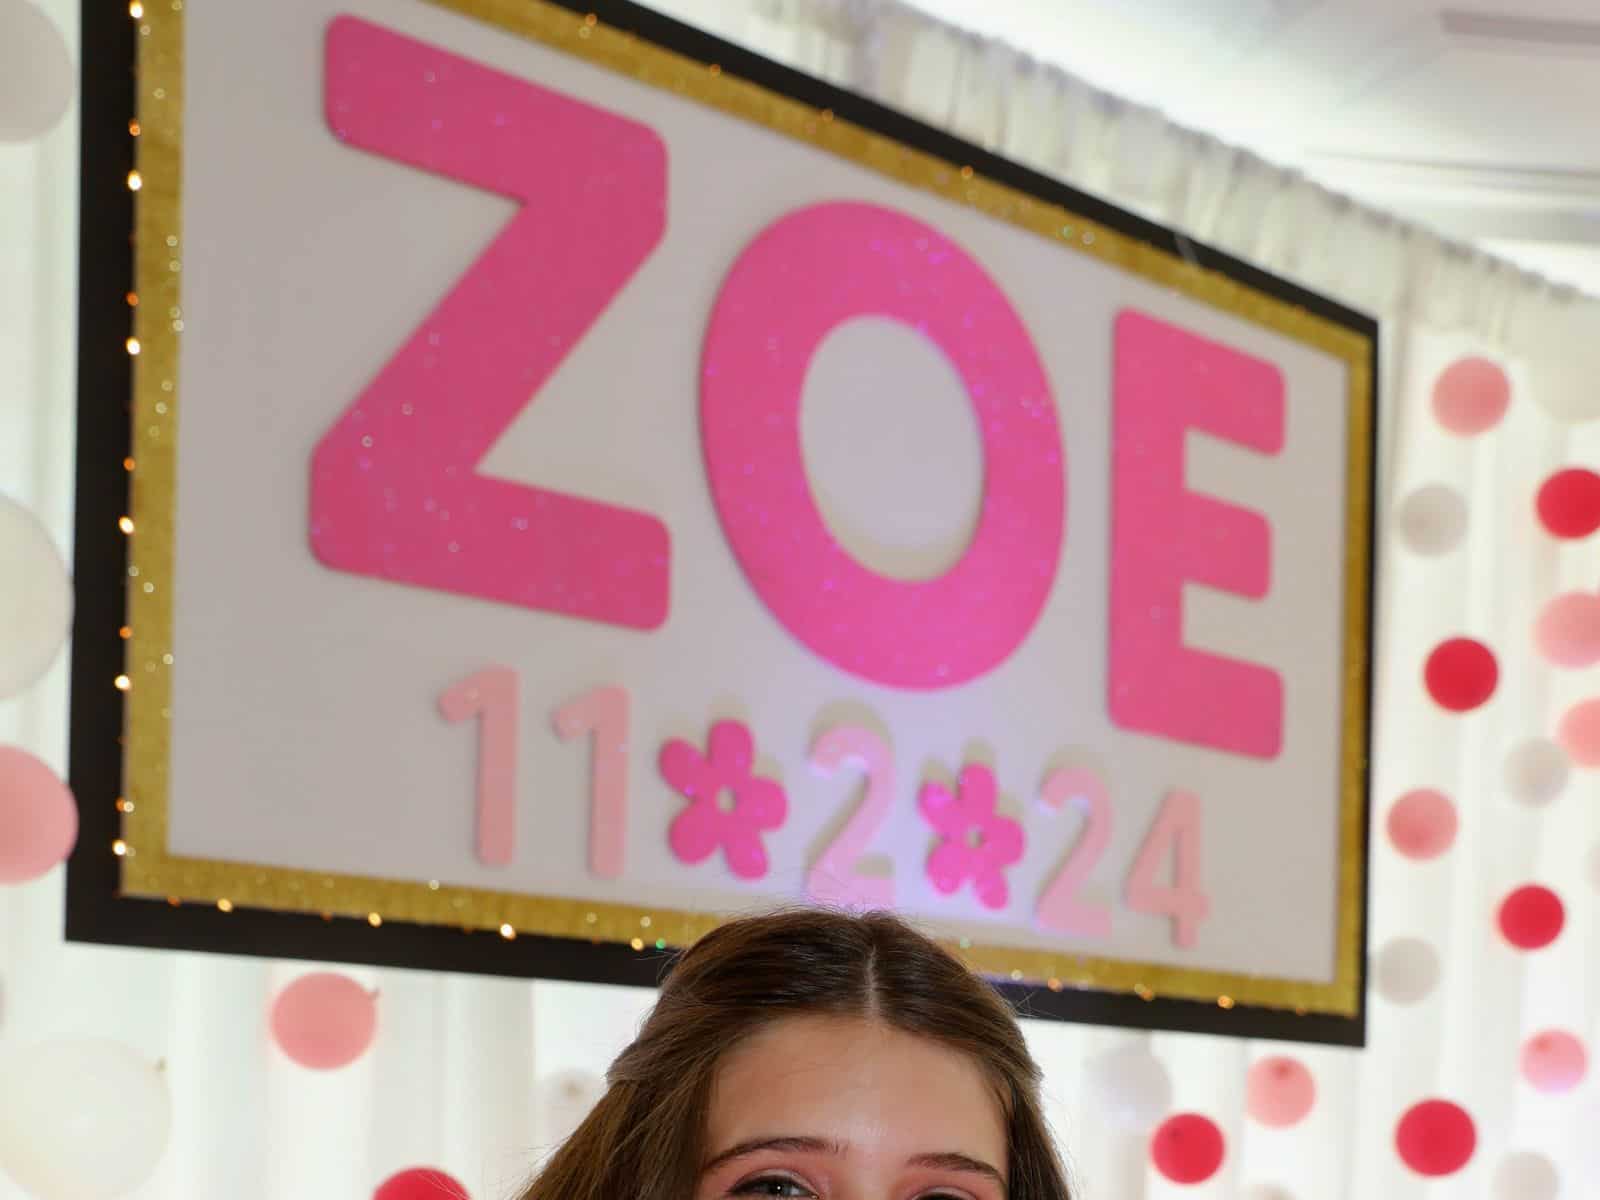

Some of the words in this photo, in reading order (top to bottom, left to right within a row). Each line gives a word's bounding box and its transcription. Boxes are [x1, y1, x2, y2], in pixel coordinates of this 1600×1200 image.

[309, 14, 1286, 760] ZOE
[437, 663, 631, 878] 11
[806, 723, 896, 908] 2
[1034, 765, 1212, 950] 24
